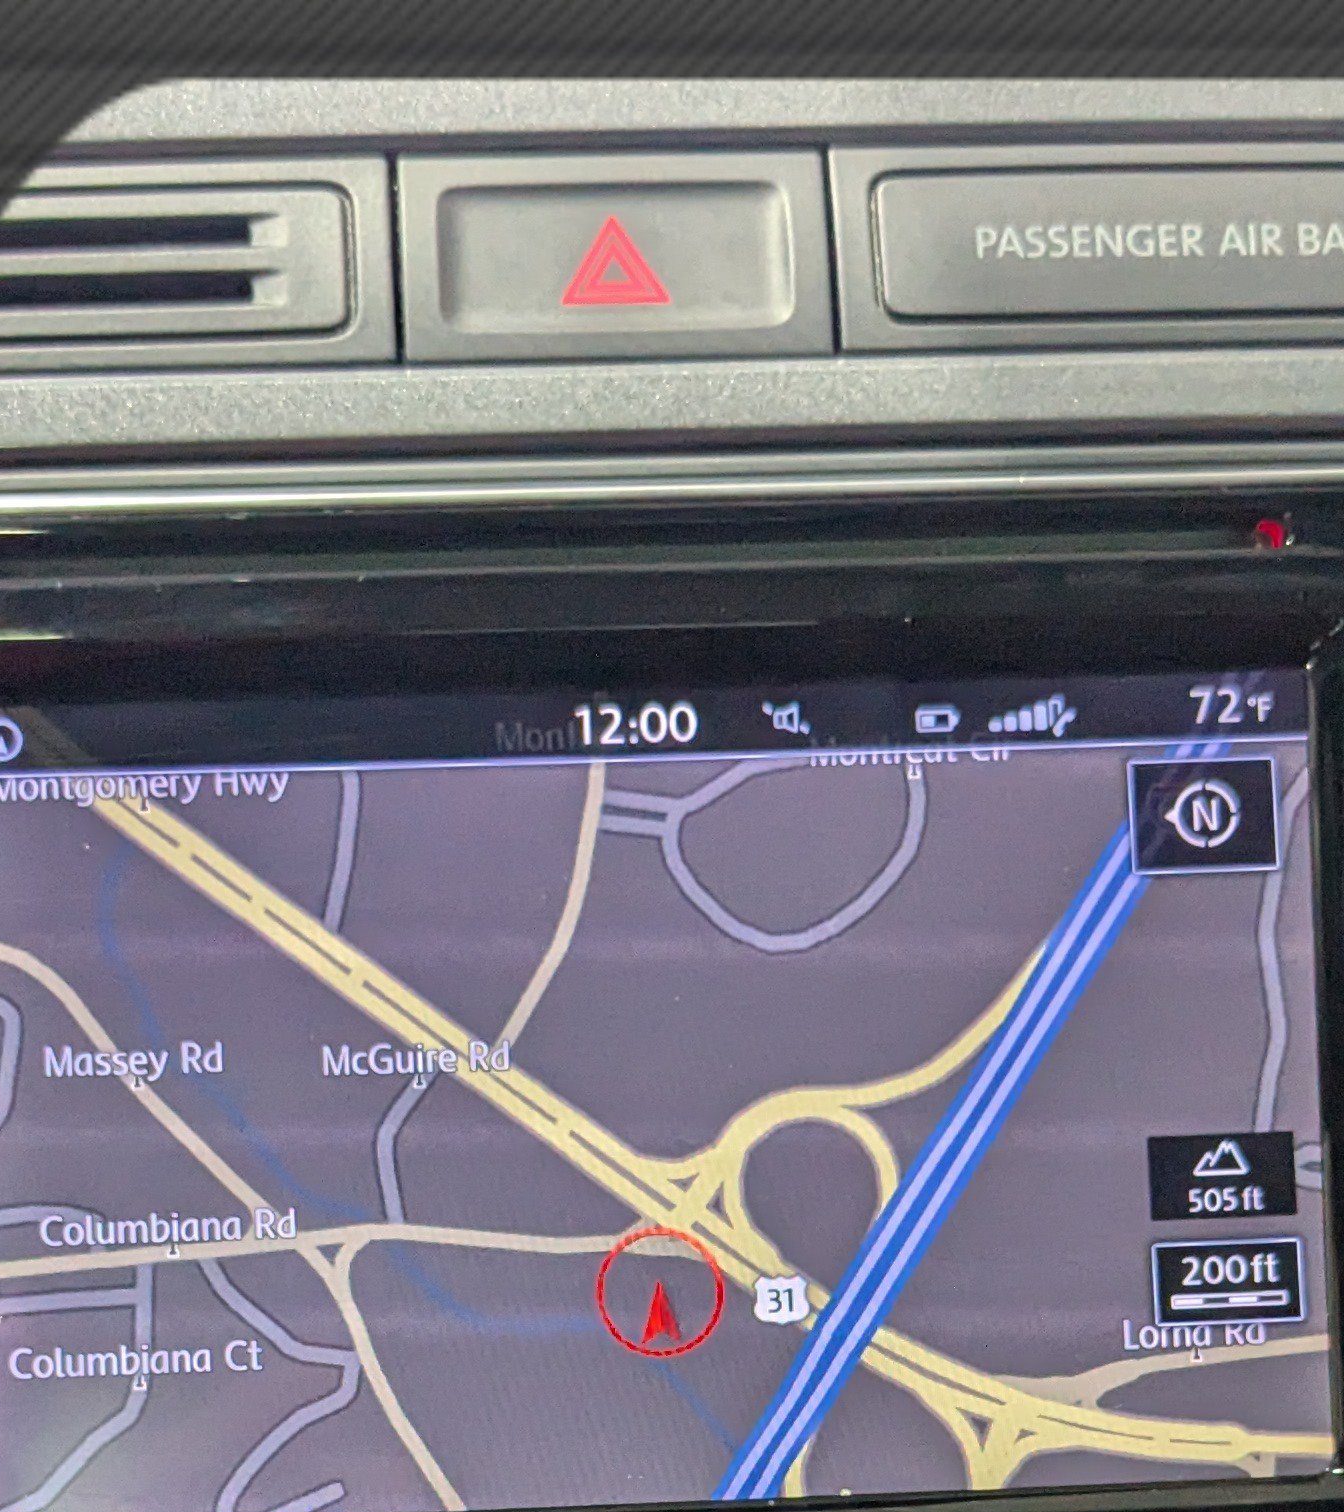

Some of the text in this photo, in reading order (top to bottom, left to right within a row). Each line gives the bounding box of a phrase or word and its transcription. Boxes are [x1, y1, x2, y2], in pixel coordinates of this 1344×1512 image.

[975, 222, 1205, 260] PASSENGER
[1219, 221, 1284, 257] AIR
[573, 702, 698, 746] 12:00
[213, 770, 289, 803] Hwy
[1192, 796, 1221, 833] N
[43, 1041, 224, 1082] Massey Rd
[322, 1040, 511, 1077] McGuire Rd
[40, 1207, 297, 1248] Columbiana Rd
[767, 1286, 795, 1313] 31
[1123, 1319, 1211, 1350] Lorna
[8, 1339, 263, 1380] Columbiana Ct
